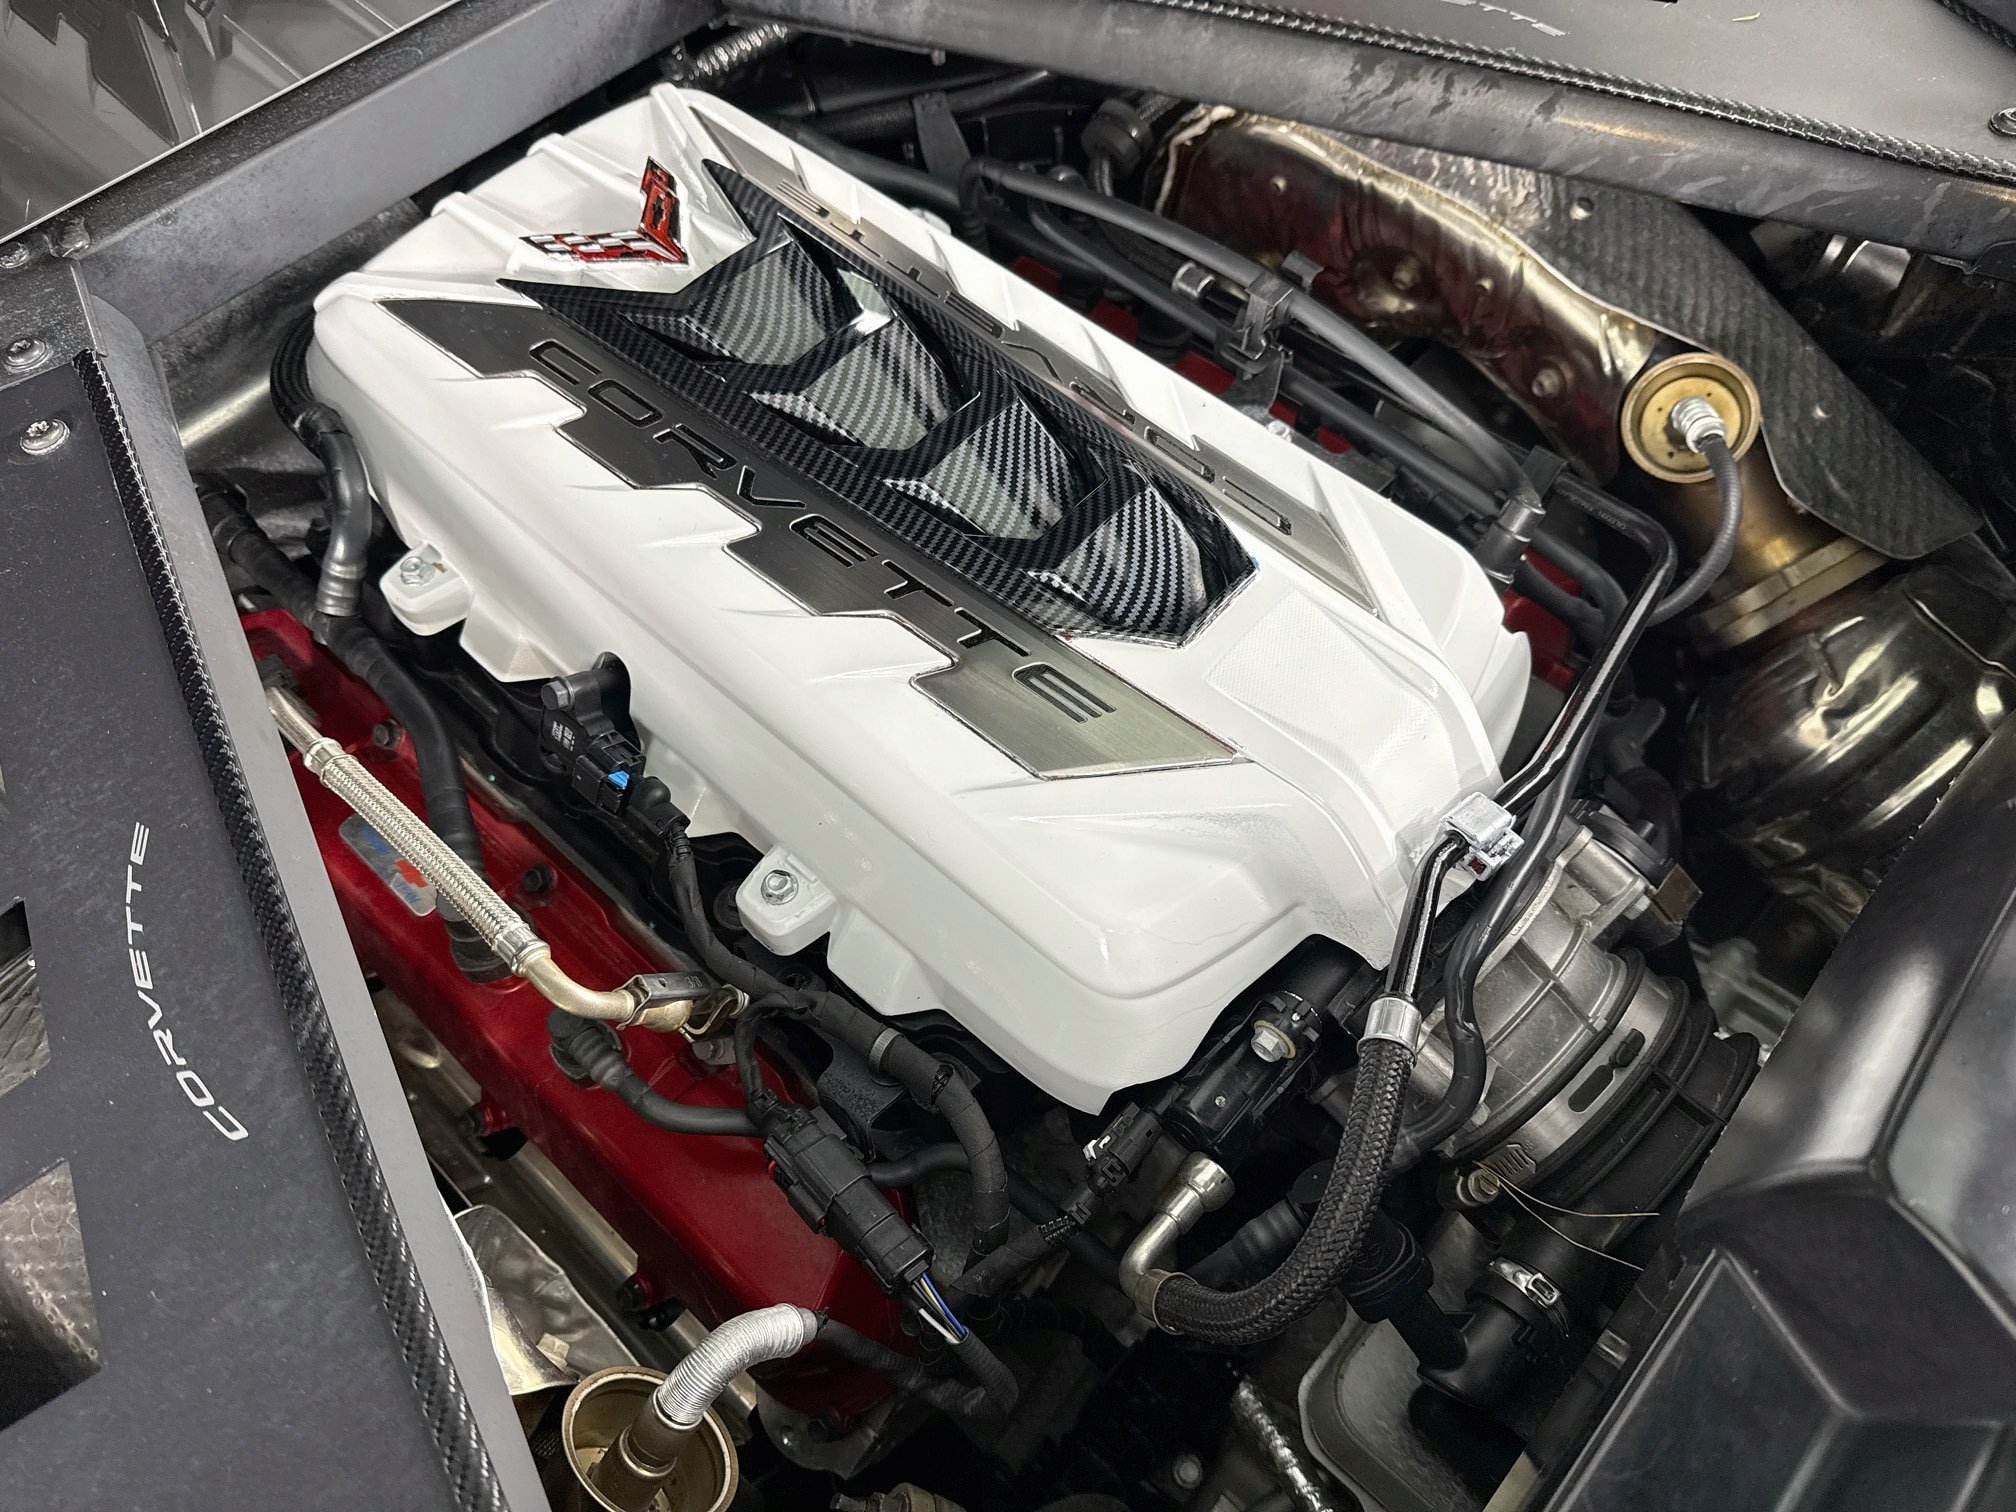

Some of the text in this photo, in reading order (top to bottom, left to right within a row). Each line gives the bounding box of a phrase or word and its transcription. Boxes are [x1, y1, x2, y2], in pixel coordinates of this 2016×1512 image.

[528, 339, 1116, 723] CORVETTE
[777, 179, 1292, 535] CORVETTE
[126, 822, 249, 1140] CORVETTE
